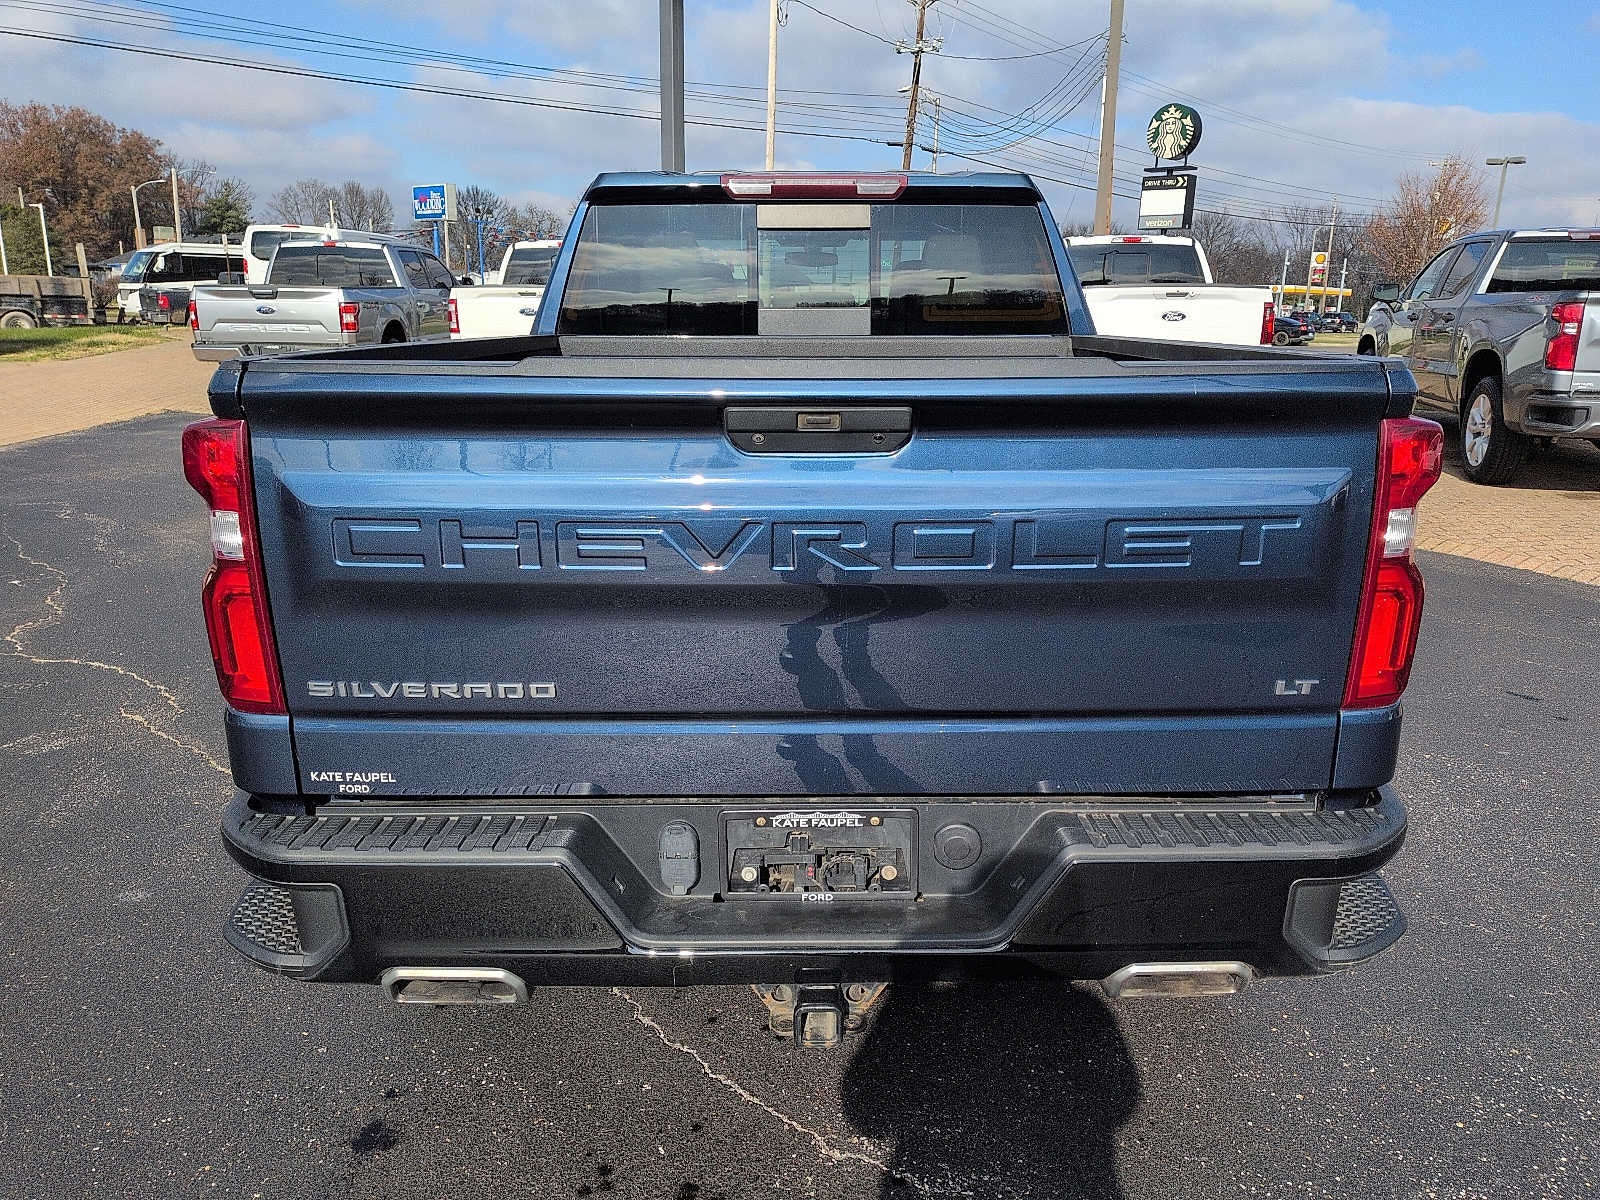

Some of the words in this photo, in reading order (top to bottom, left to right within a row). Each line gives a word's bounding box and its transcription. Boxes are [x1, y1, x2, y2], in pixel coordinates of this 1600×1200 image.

[1145, 219, 1173, 227] verizon
[331, 516, 1302, 572] CHEVROLET
[307, 680, 557, 699] SILVERADO
[1275, 680, 1320, 696] LT
[310, 771, 343, 783] KATE
[345, 772, 397, 783] FAUPEL
[339, 784, 370, 794] FORD
[772, 818, 809, 828] KATE
[811, 818, 864, 828] FAUPEL
[801, 893, 834, 902] FORD
